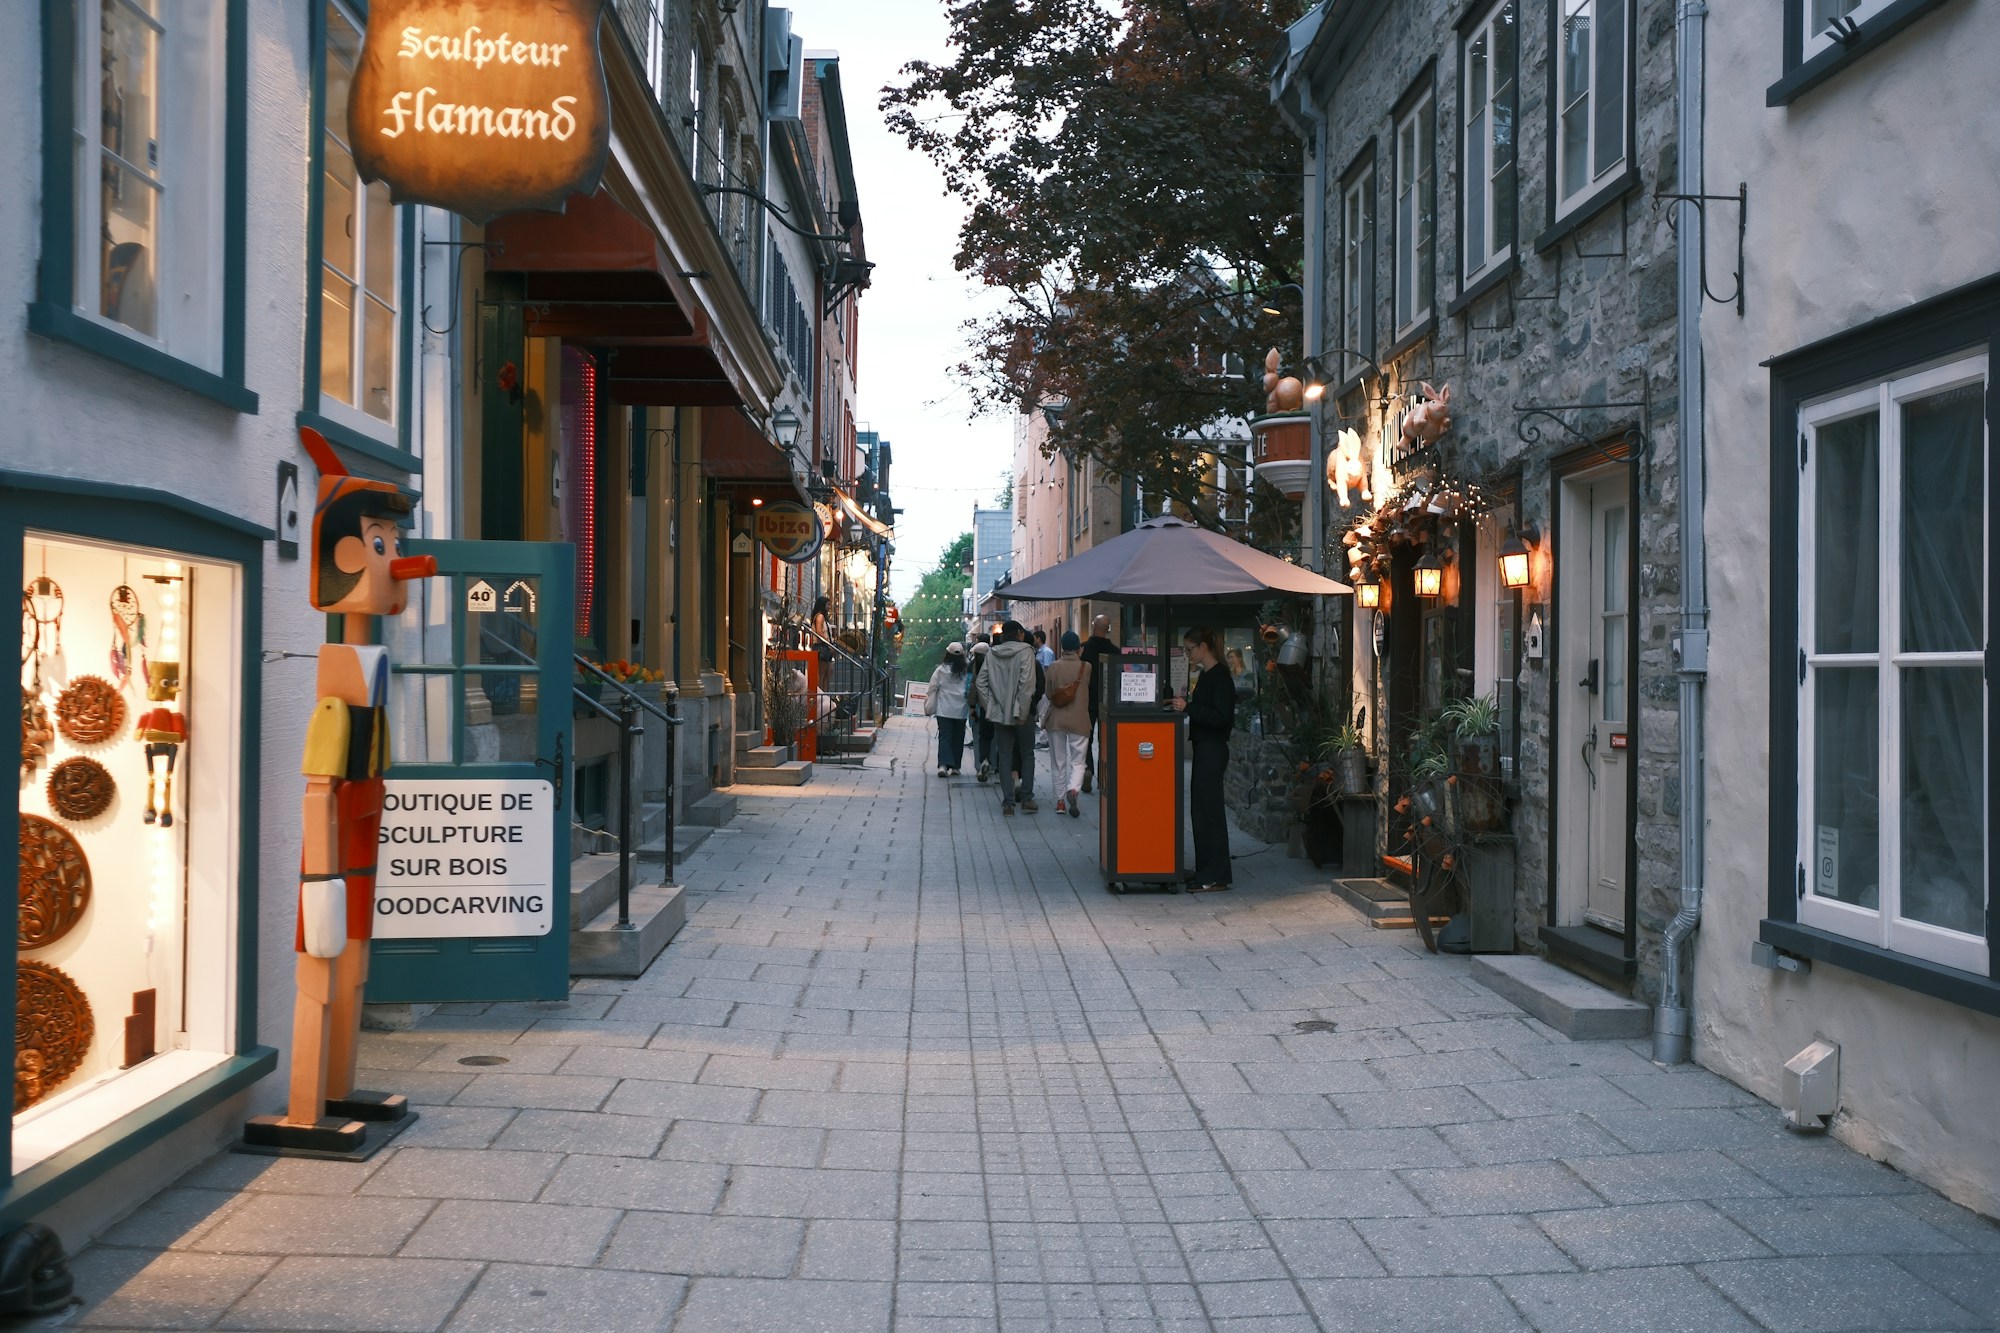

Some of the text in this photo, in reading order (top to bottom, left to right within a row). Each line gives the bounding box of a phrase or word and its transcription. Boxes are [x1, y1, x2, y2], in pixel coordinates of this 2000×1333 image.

[397, 26, 569, 70] Sculpteur
[380, 86, 578, 142] Flamand
[759, 515, 810, 534] Ibiza
[471, 591, 490, 602] 40
[382, 793, 533, 815] OUTIQUE DE
[378, 825, 523, 844] SCULPTURE
[389, 858, 508, 876] SUR BOIS
[373, 895, 544, 915] OODCARVING
